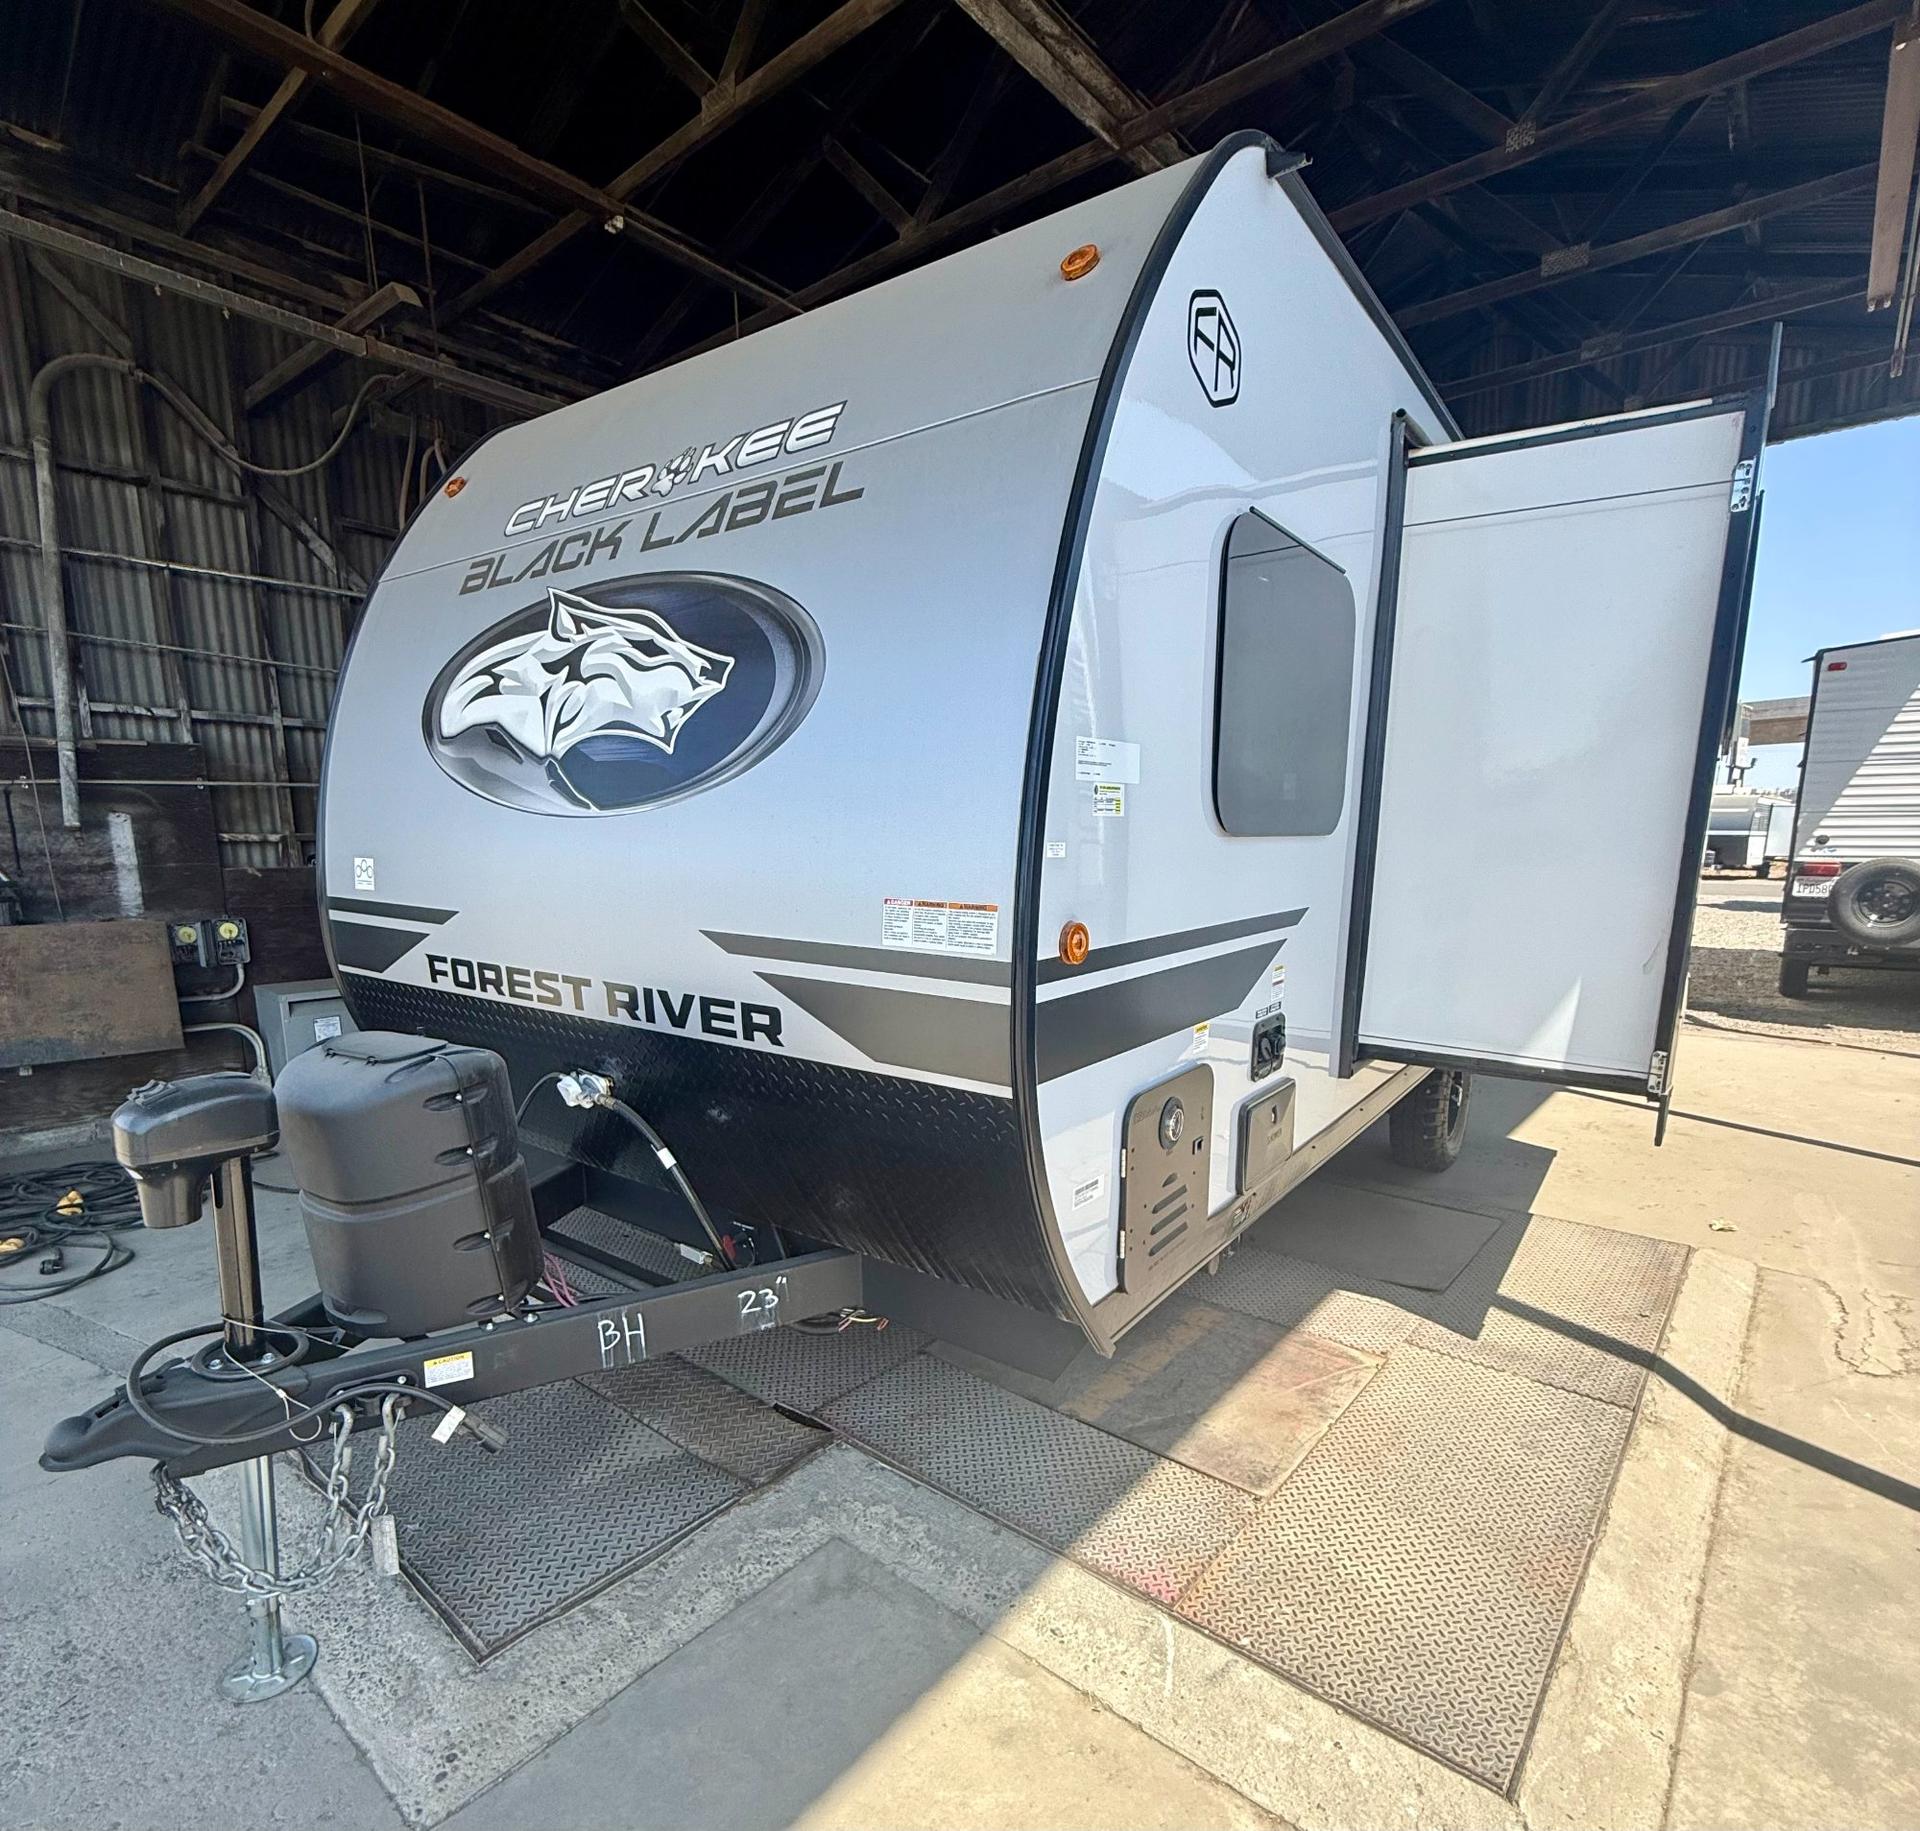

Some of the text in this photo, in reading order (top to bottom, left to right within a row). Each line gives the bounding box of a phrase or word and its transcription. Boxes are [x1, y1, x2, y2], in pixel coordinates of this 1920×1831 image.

[503, 400, 848, 537] CHEROKEE
[458, 460, 866, 596] BLACK LABEL
[426, 954, 785, 1047] FOREST RIVER
[737, 1276, 787, 1314] 23"
[438, 1354, 464, 1365] CAUTION
[598, 1310, 647, 1364] BH
